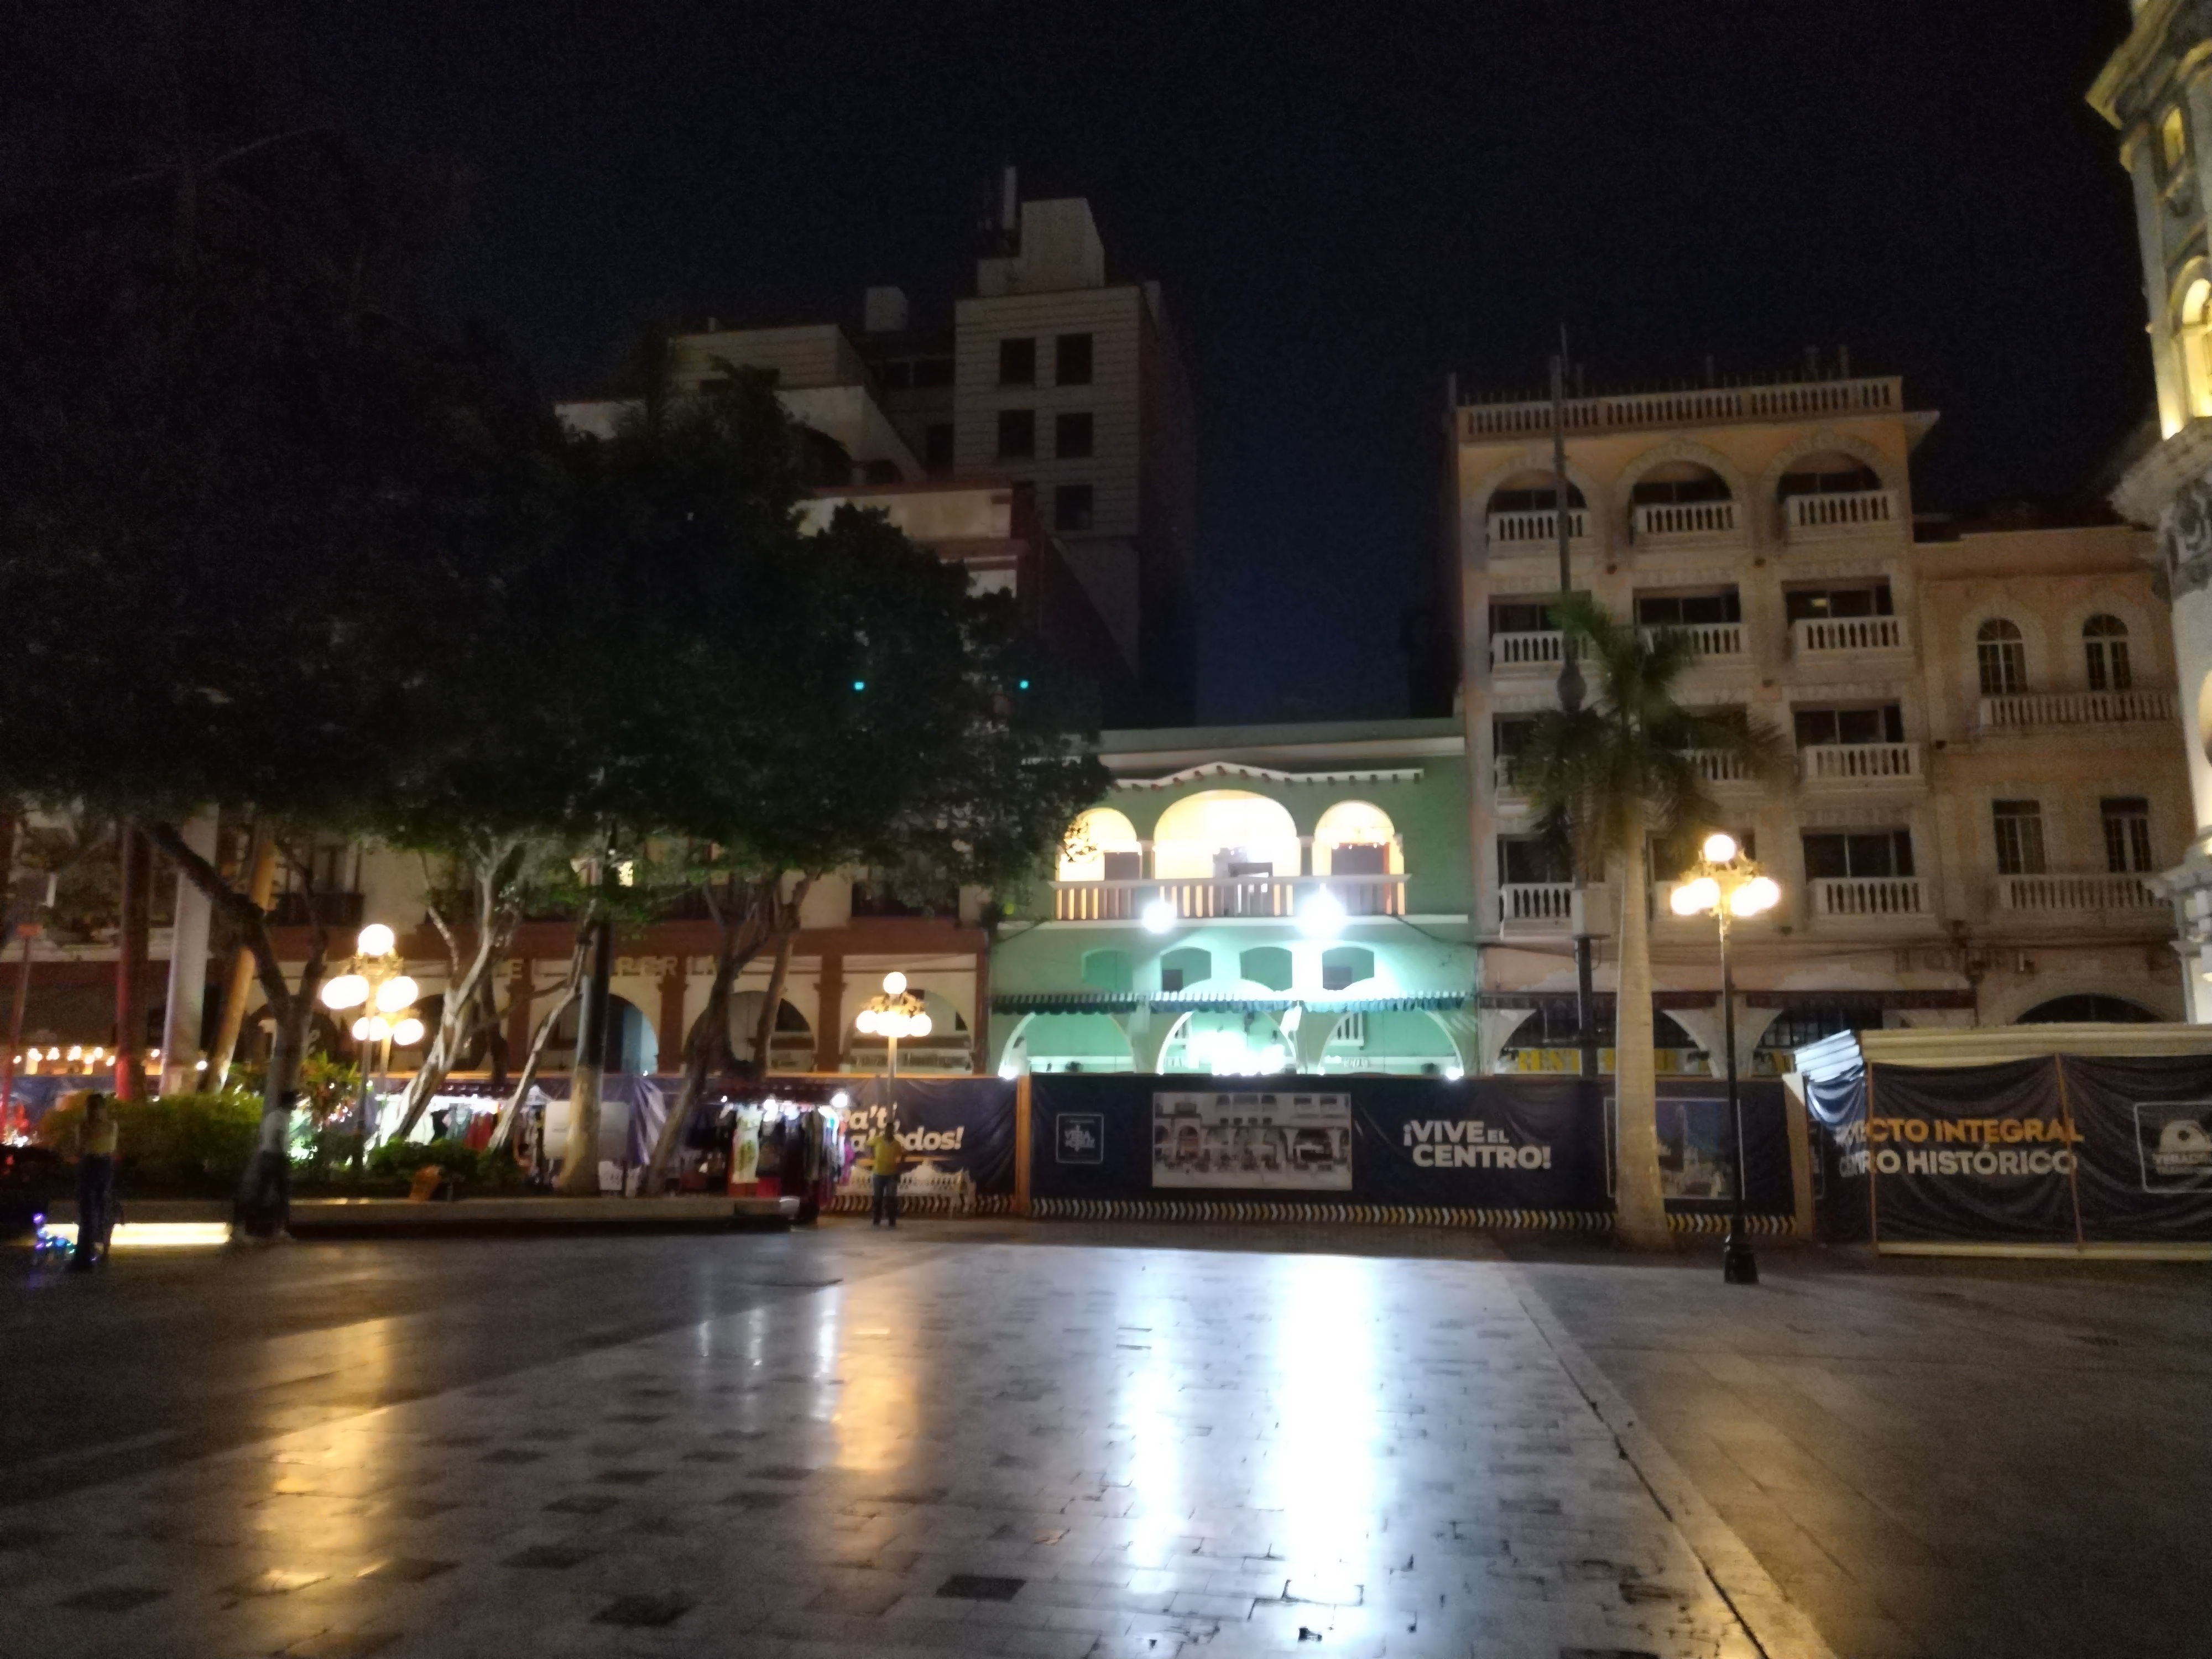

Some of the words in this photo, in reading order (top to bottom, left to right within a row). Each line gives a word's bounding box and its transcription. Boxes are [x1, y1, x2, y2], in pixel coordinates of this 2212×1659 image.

[1403, 1119, 1485, 1146] ¡VIVE
[1487, 1129, 1510, 1144] EL
[1933, 1117, 2085, 1144] INTEGRAL
[1412, 1144, 1552, 1169] CENTRO!
[1906, 1141, 2078, 1176] HISTÓRICO
